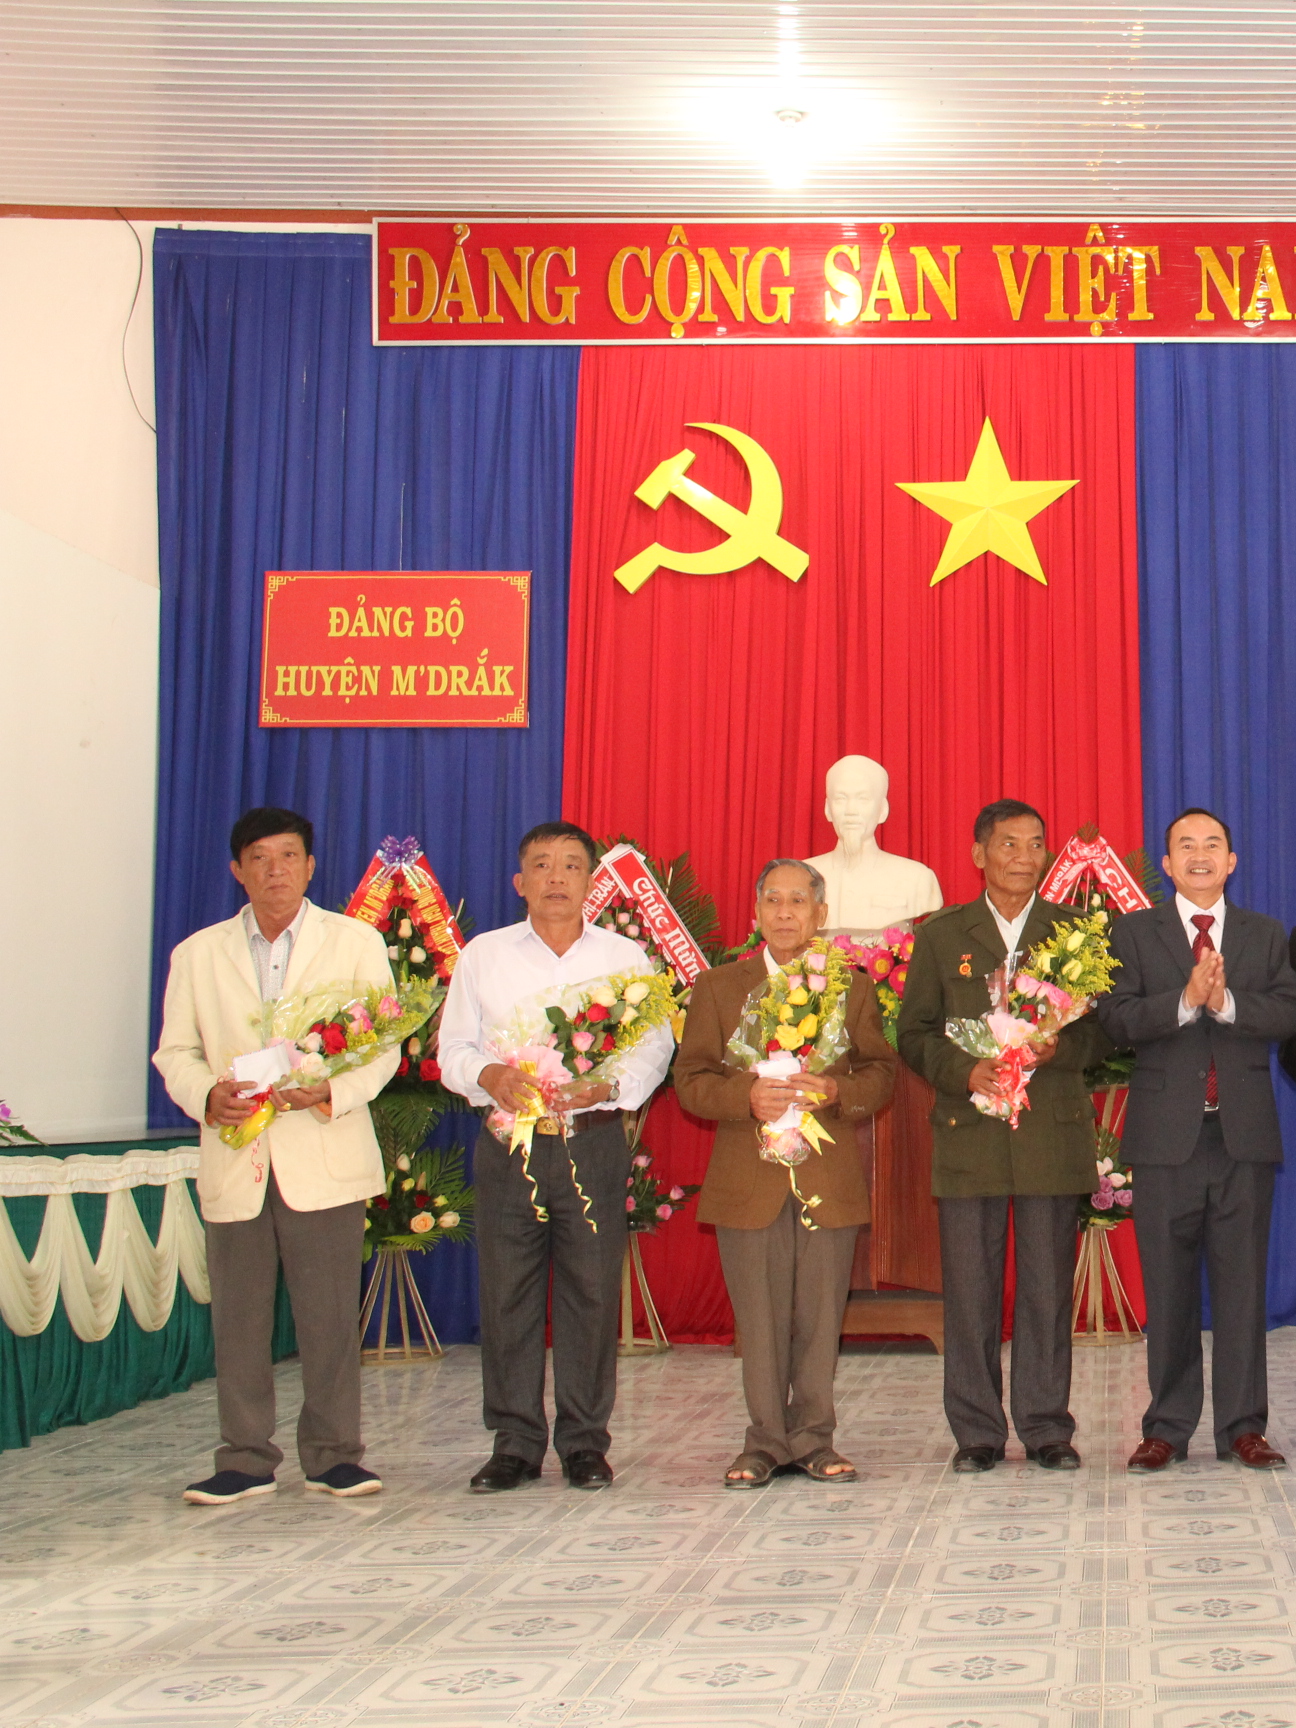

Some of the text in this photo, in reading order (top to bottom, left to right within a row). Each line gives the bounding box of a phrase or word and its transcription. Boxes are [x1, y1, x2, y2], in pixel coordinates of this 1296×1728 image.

[388, 223, 580, 326] ĐẢNG
[608, 225, 796, 340] CỘNG
[823, 222, 963, 325] SẢN
[992, 223, 1161, 337] VIỆT
[327, 594, 465, 645] ĐẢNG BỘ
[274, 647, 515, 704] HUYỆN M'DRẮK
[632, 876, 702, 982] Chúc Mừn
